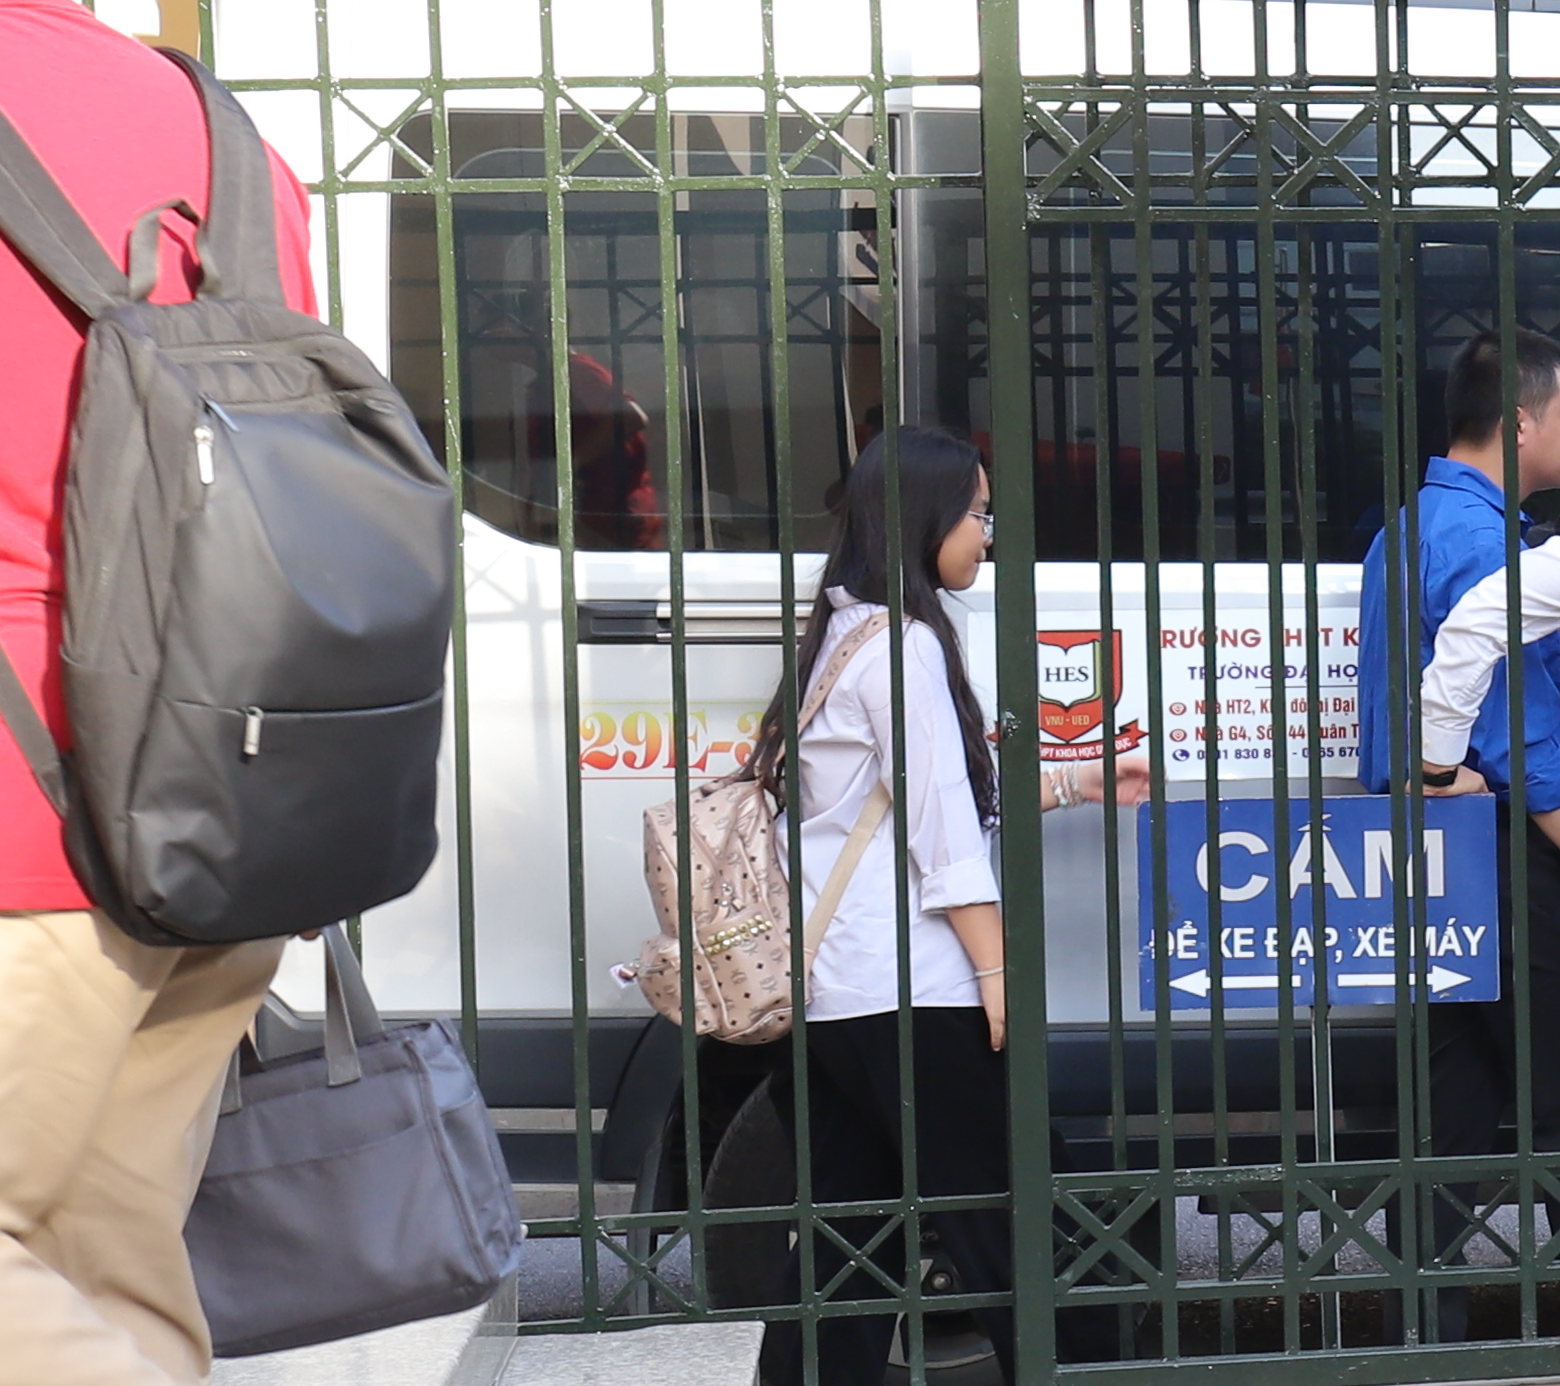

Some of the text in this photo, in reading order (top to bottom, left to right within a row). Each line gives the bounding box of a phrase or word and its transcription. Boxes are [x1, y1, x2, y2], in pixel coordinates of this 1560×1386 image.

[1044, 666, 1089, 682] HES
[1333, 696, 1355, 717] Đại
[1045, 715, 1064, 726] VNU
[1072, 714, 1090, 726] UED
[1288, 724, 1306, 740] 44
[1234, 748, 1259, 759] 830
[1195, 813, 1446, 902] CẤM
